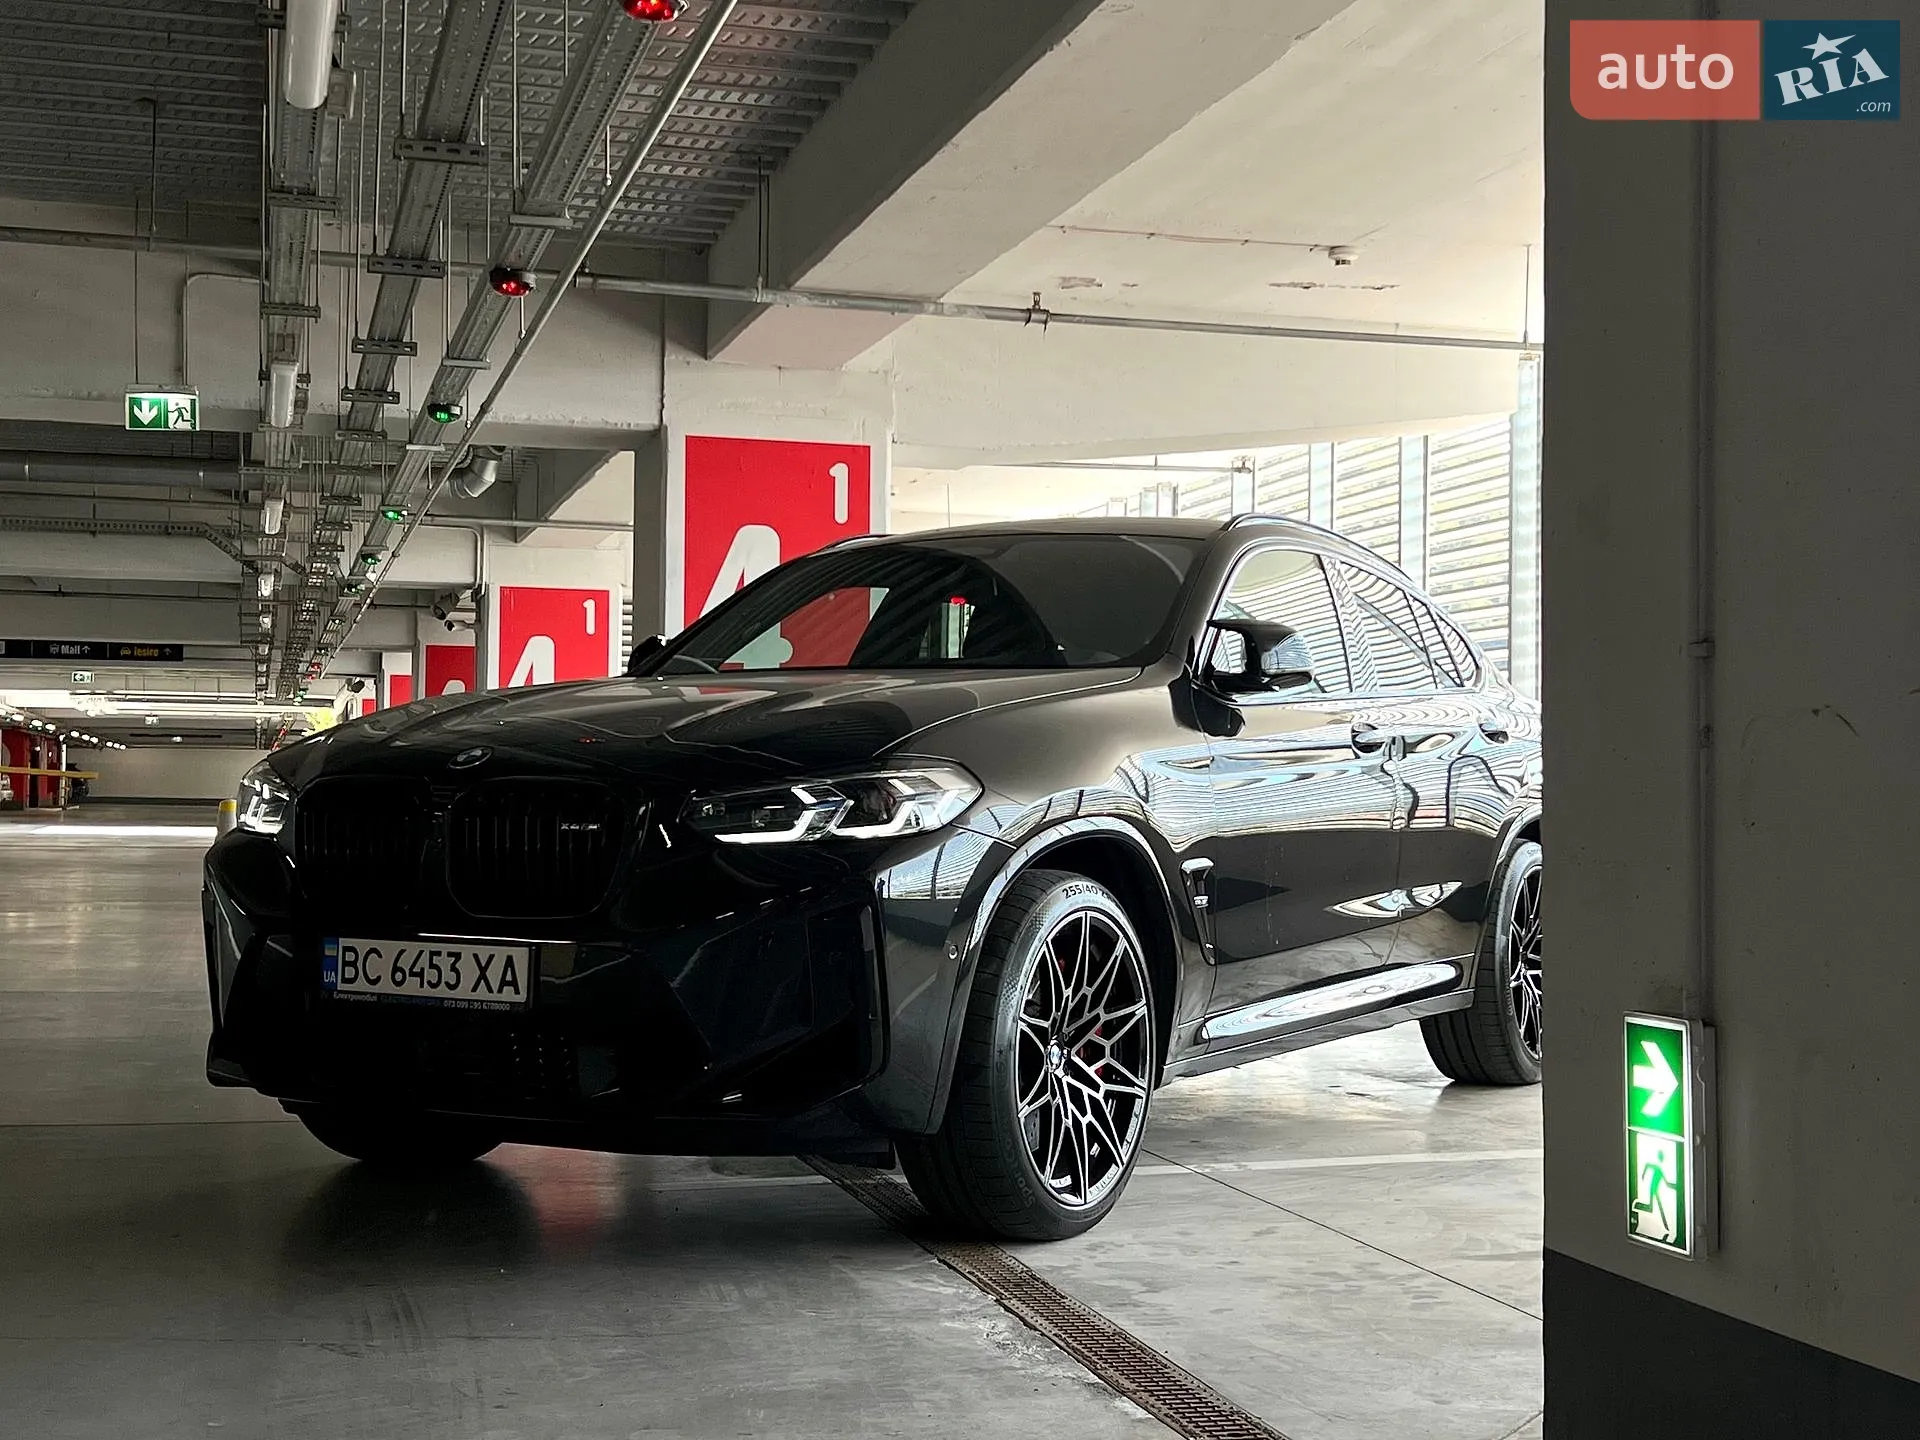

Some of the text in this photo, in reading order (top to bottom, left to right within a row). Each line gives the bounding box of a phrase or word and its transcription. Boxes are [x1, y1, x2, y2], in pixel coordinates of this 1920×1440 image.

[829, 462, 849, 524] 1
[583, 598, 596, 635] 1
[1062, 884, 1099, 899] 255/40
[324, 971, 336, 983] UA
[341, 945, 521, 995] BC 6453 XA
